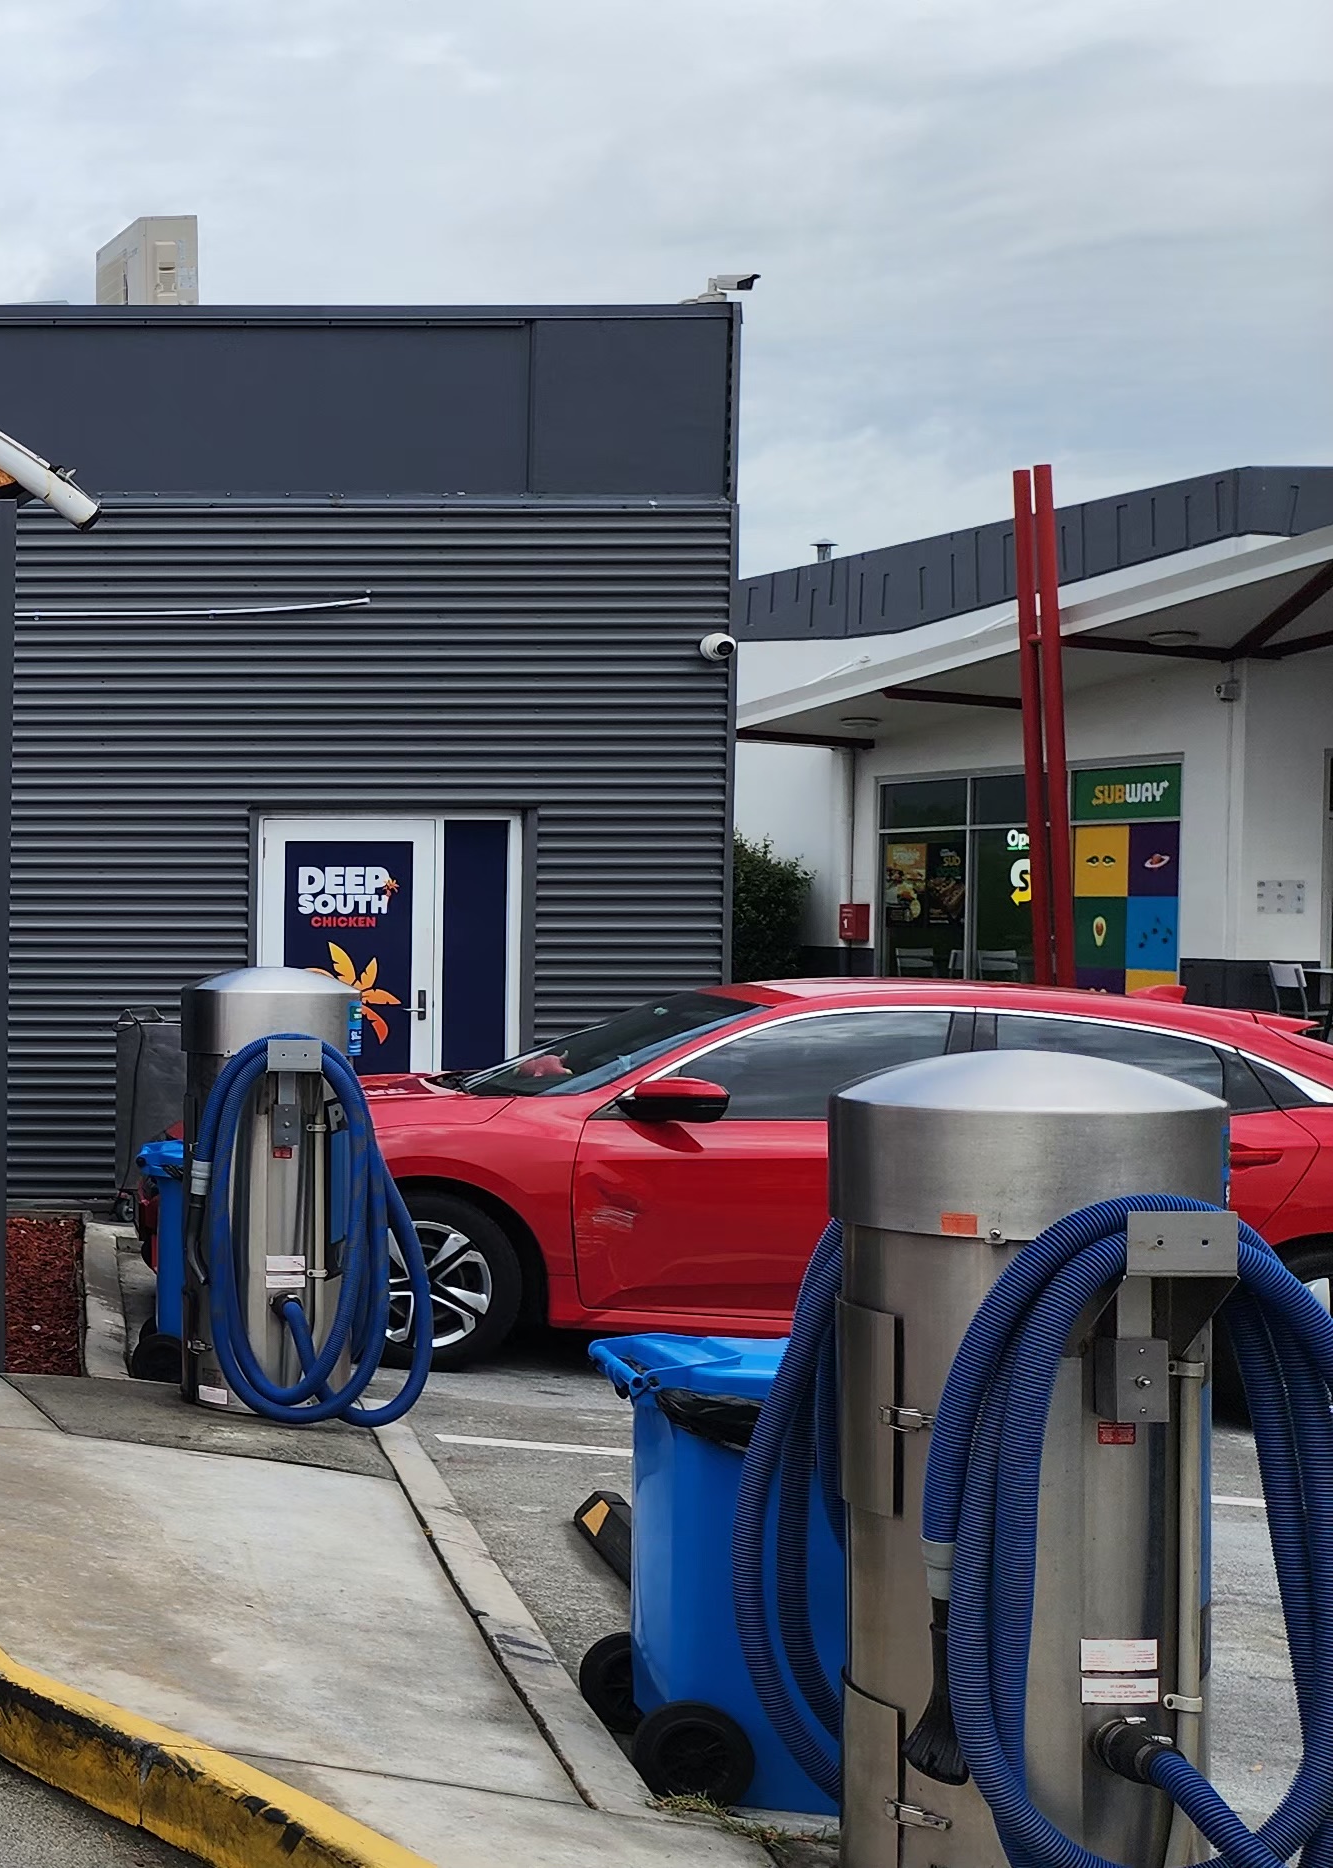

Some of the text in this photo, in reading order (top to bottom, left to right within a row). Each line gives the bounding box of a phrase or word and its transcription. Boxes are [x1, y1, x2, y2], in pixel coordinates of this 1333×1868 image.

[1091, 779, 1169, 806] SUBWAY
[298, 866, 391, 895] DEEP
[297, 893, 389, 915] SOUTH
[310, 916, 376, 928] CHICKEN
